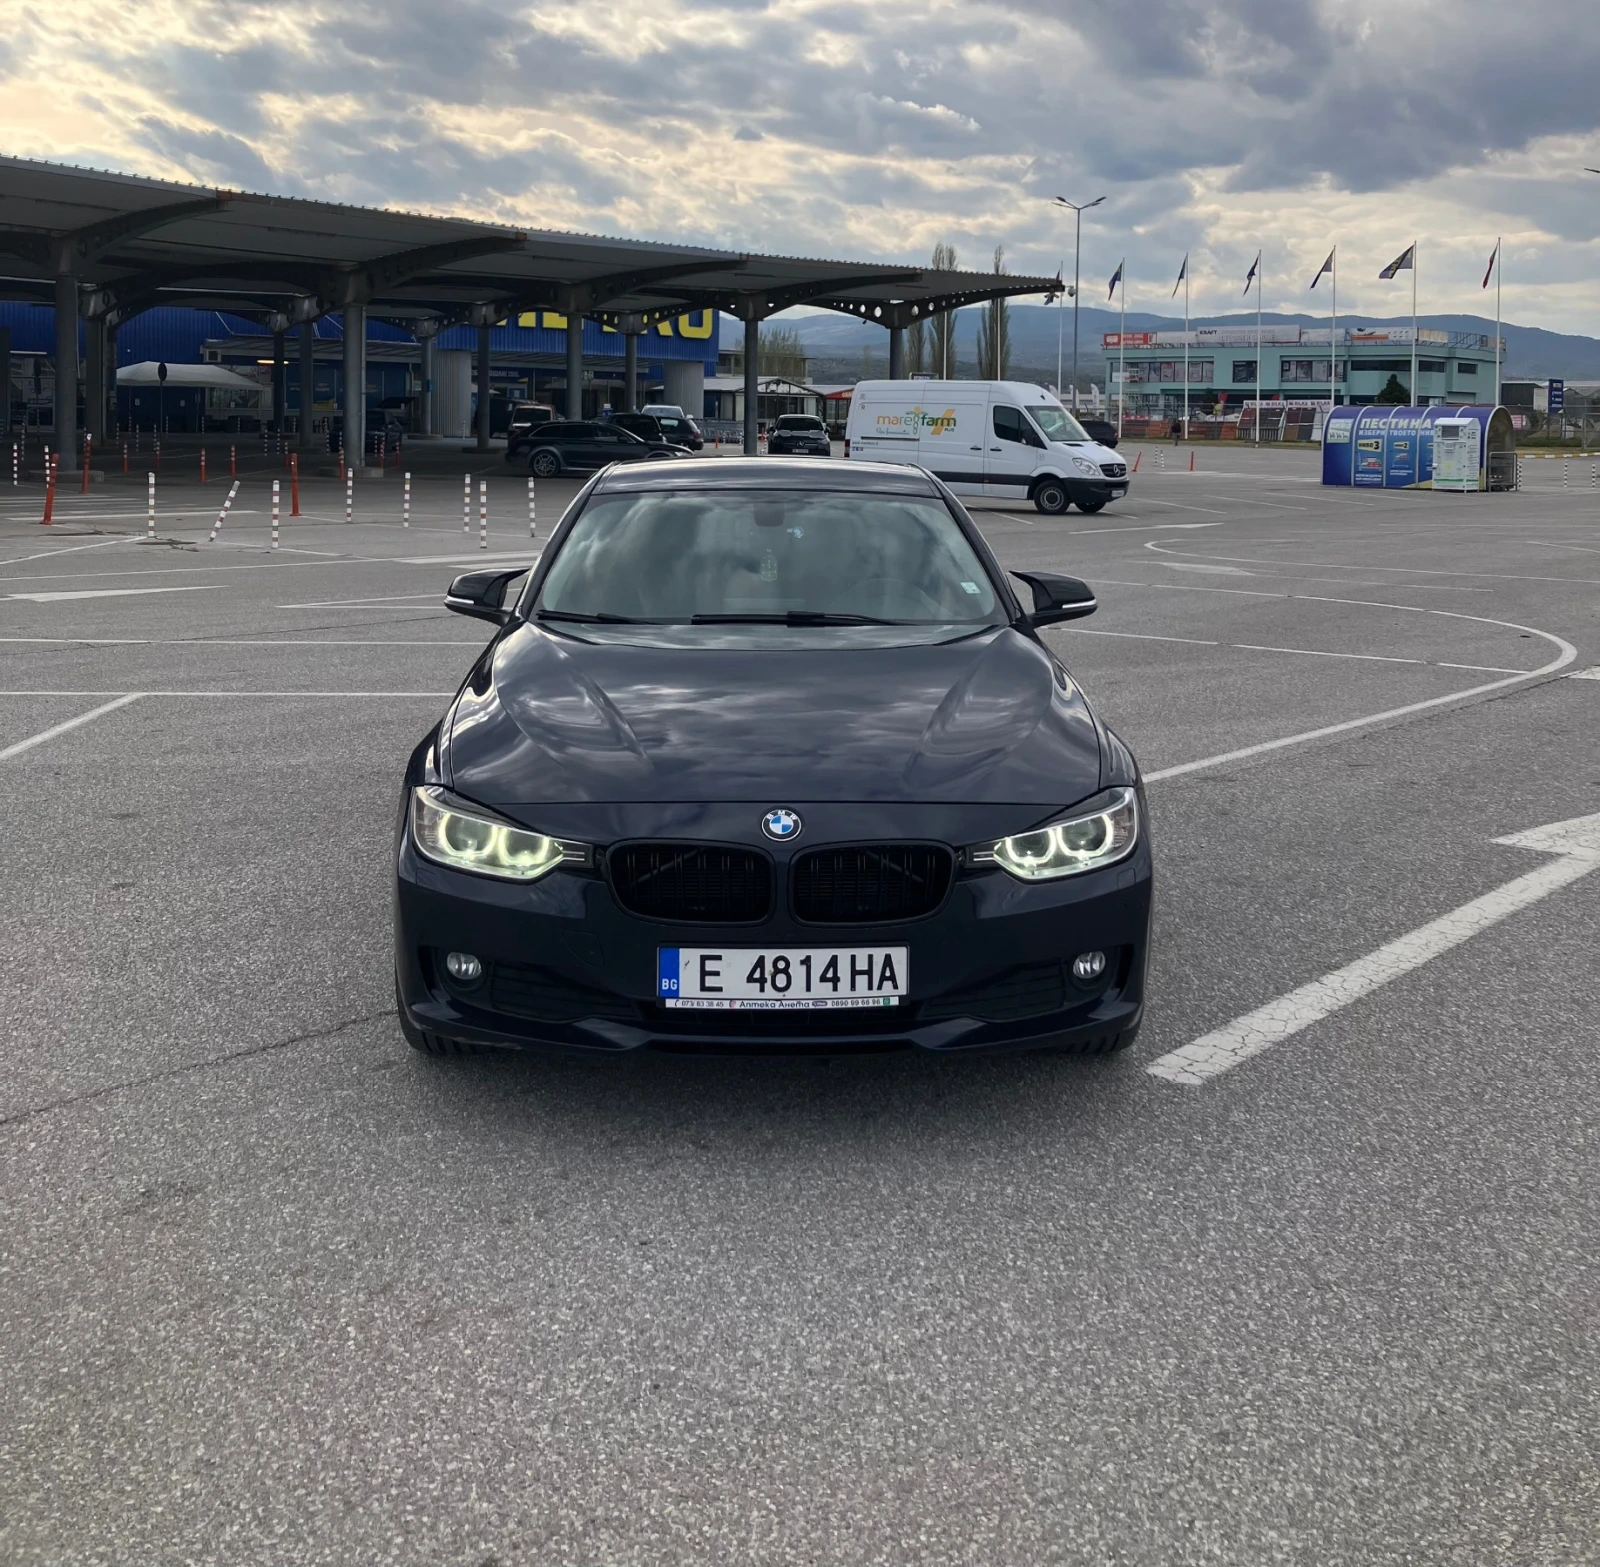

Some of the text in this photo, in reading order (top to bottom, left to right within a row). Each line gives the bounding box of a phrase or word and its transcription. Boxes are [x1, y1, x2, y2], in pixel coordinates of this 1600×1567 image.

[1360, 418, 1432, 429] ПЕСТИНА
[1374, 441, 1380, 450] 3
[699, 954, 724, 992] E
[661, 978, 677, 990] BG
